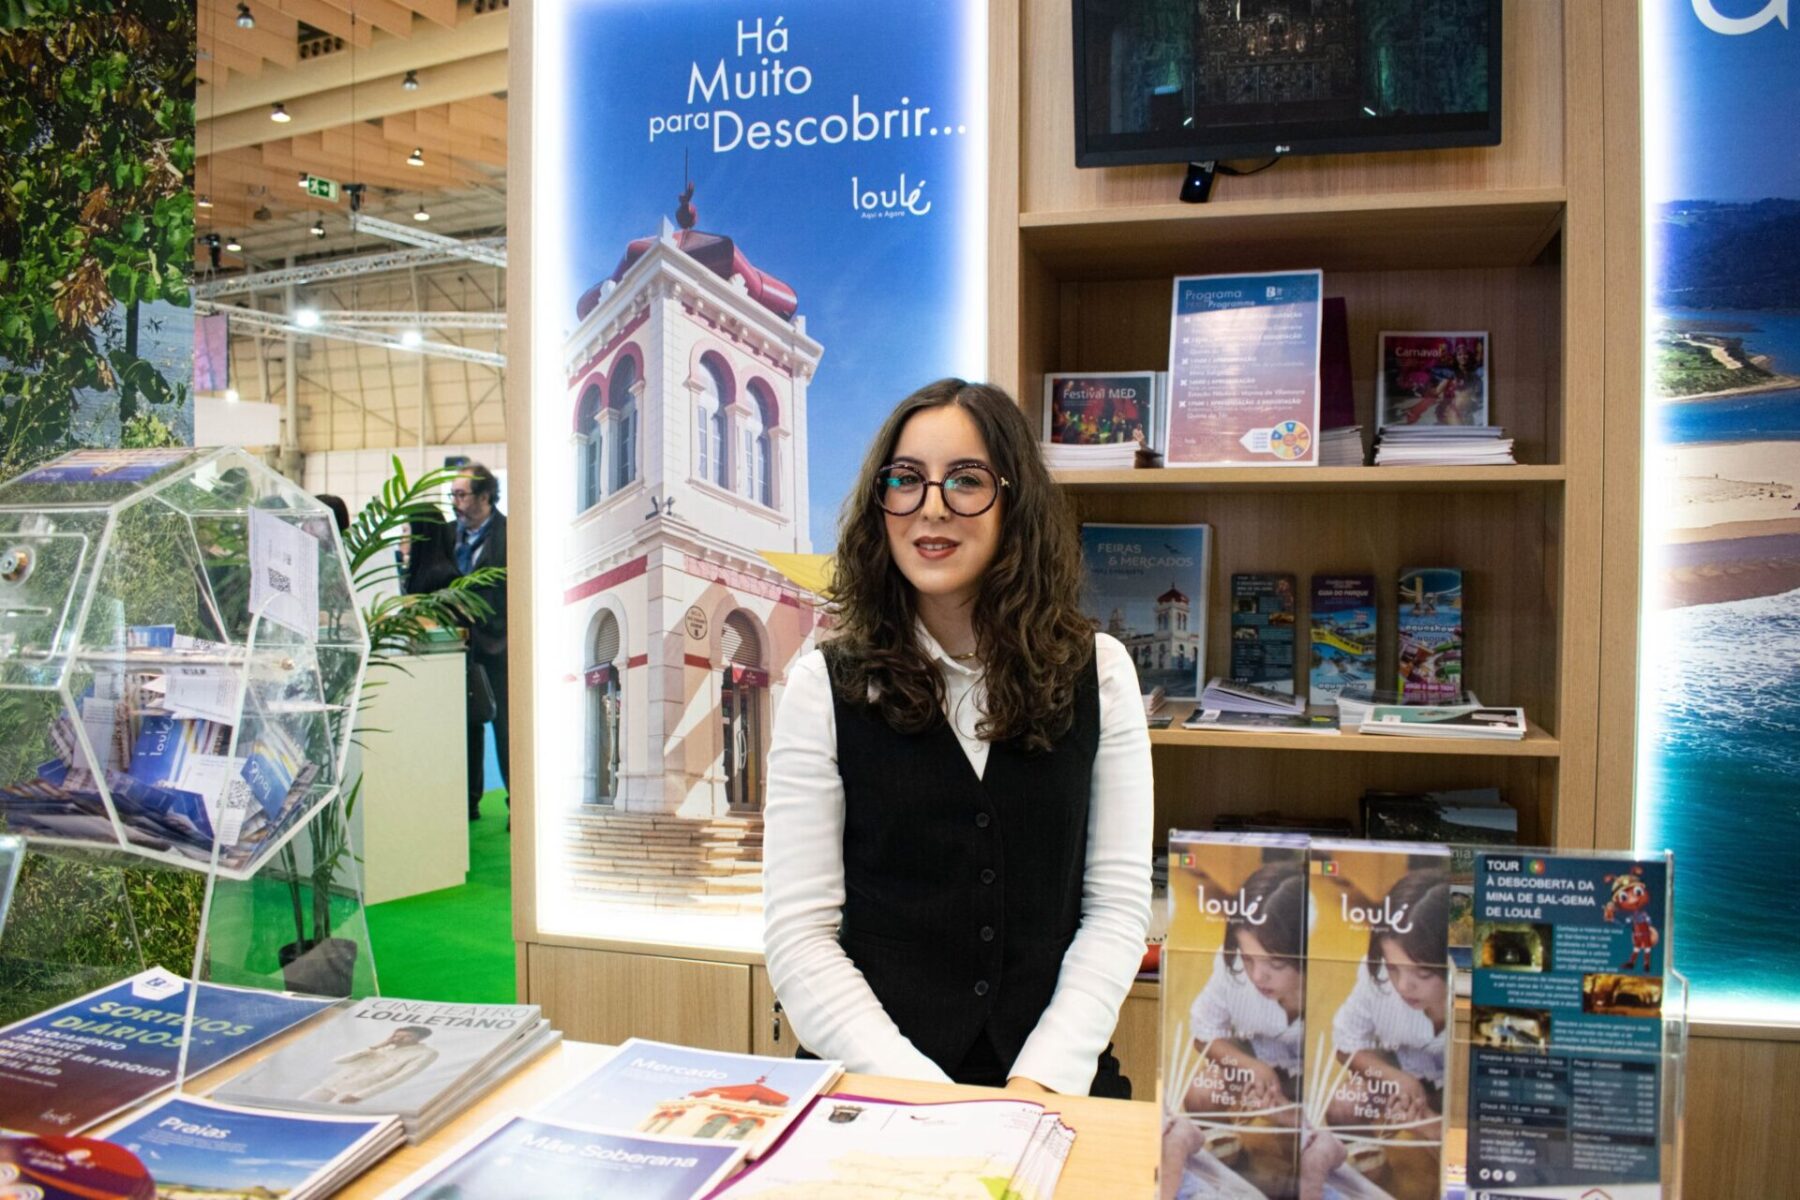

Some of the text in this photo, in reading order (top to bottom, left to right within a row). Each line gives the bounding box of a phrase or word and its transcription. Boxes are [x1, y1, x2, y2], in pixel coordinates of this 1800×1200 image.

[737, 16, 789, 57] Há
[687, 58, 812, 104] Muito
[650, 95, 967, 153] para Descobrir...
[852, 173, 931, 215] loulé
[1185, 289, 1242, 304] Programa
[1395, 346, 1442, 358] Carnaval
[1063, 387, 1136, 399] Festival MED
[1097, 543, 1142, 555] FEIRAS
[1120, 556, 1194, 568] MERCADOS
[1486, 860, 1520, 872] TOUR
[1486, 875, 1595, 891] À DESCOBERTA DA
[1198, 885, 1267, 925] loulé
[1486, 892, 1596, 907] MINA DE SAL-GEMA
[1341, 893, 1413, 934] loulé
[1485, 906, 1542, 919] DE LOULÉ
[372, 1000, 531, 1019] CINETEATRO
[355, 1009, 518, 1030] LOULETANO
[50, 1015, 195, 1048] DIÁRIOS
[71, 1053, 97, 1064] EM
[95, 1058, 170, 1077] PARQUES
[630, 1057, 728, 1080] Mercado
[1193, 1072, 1225, 1090] dois
[1224, 1068, 1255, 1083] um
[1335, 1083, 1369, 1103] dois
[1368, 1079, 1399, 1095] um
[1211, 1090, 1236, 1106] três
[1354, 1104, 1380, 1118] três
[157, 1116, 232, 1140] Praias
[520, 1133, 699, 1169] Mãe Soberana
